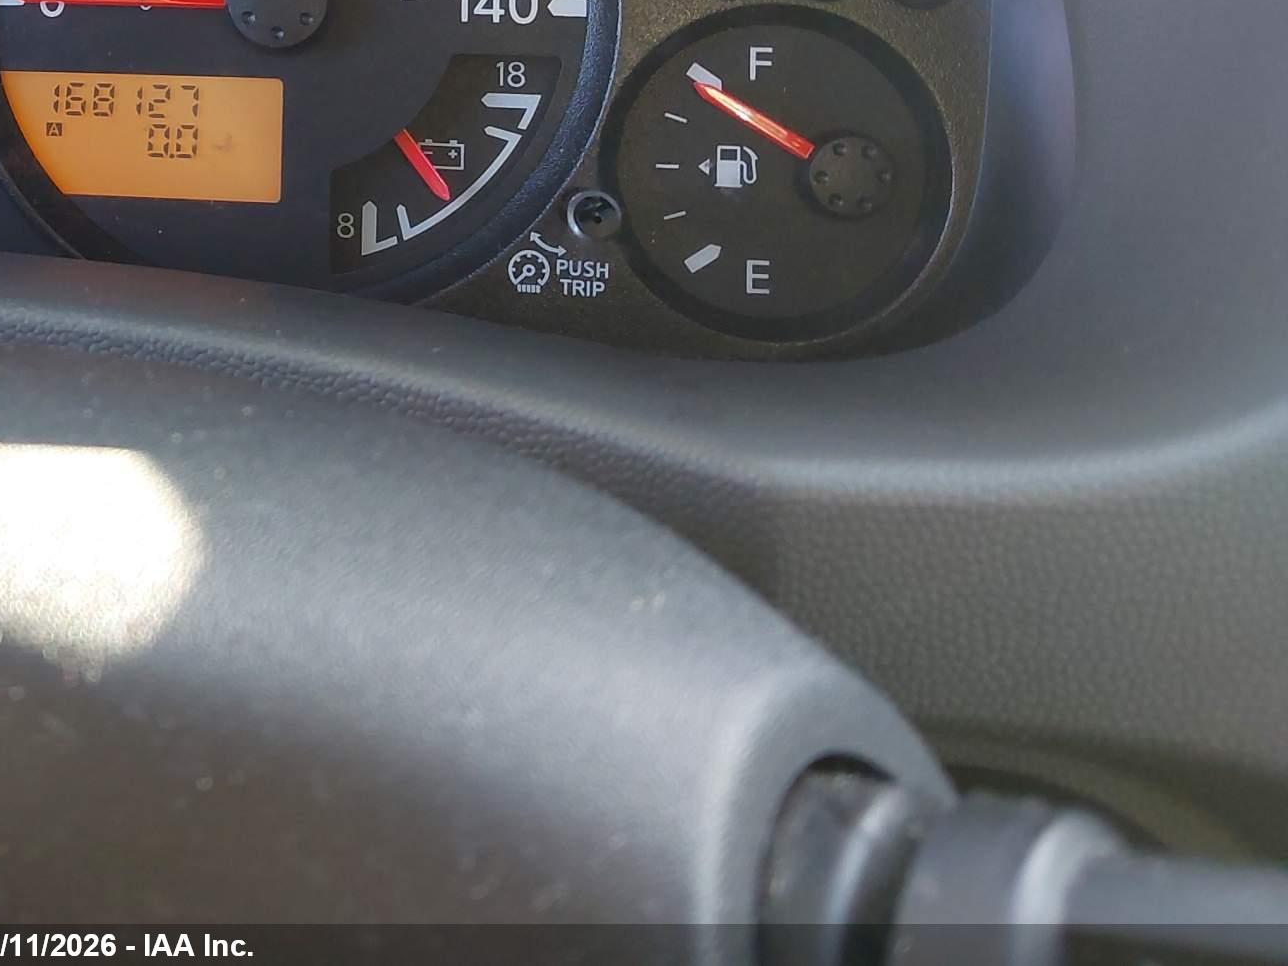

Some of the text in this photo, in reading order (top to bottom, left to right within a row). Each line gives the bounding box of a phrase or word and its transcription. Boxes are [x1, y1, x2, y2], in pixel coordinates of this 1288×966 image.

[496, 62, 526, 86] 18
[749, 47, 773, 80] F
[52, 83, 199, 118] 168127
[147, 124, 198, 159] 0.0
[337, 214, 354, 238] 8
[557, 259, 610, 280] PUSH
[745, 260, 770, 294] E
[560, 278, 605, 298] TRIP
